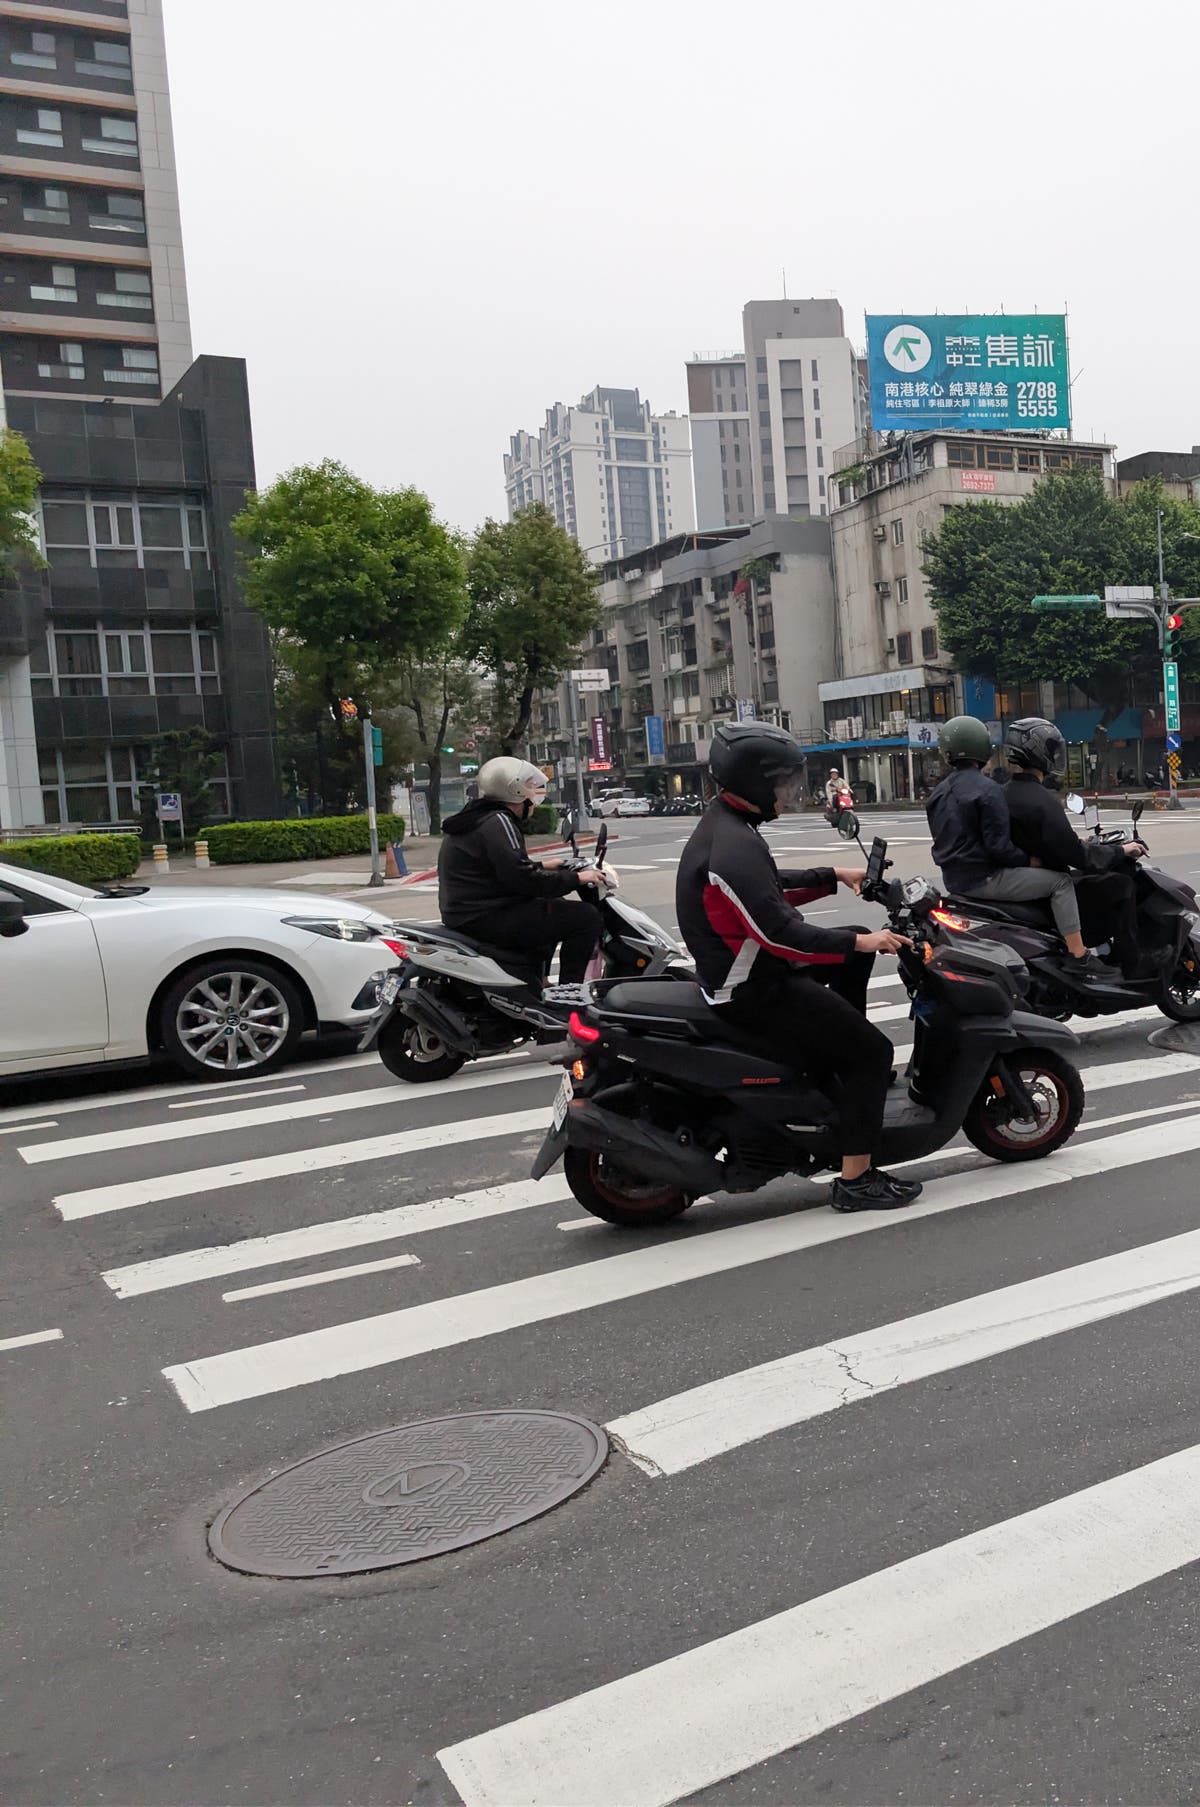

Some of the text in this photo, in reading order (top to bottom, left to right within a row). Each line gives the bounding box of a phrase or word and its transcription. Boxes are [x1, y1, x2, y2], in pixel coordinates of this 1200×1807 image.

[946, 352, 982, 367] 中工
[885, 381, 1009, 397] 南港核心 純翠綠金
[1017, 381, 1057, 399] 2788
[1018, 400, 1058, 417] 5555
